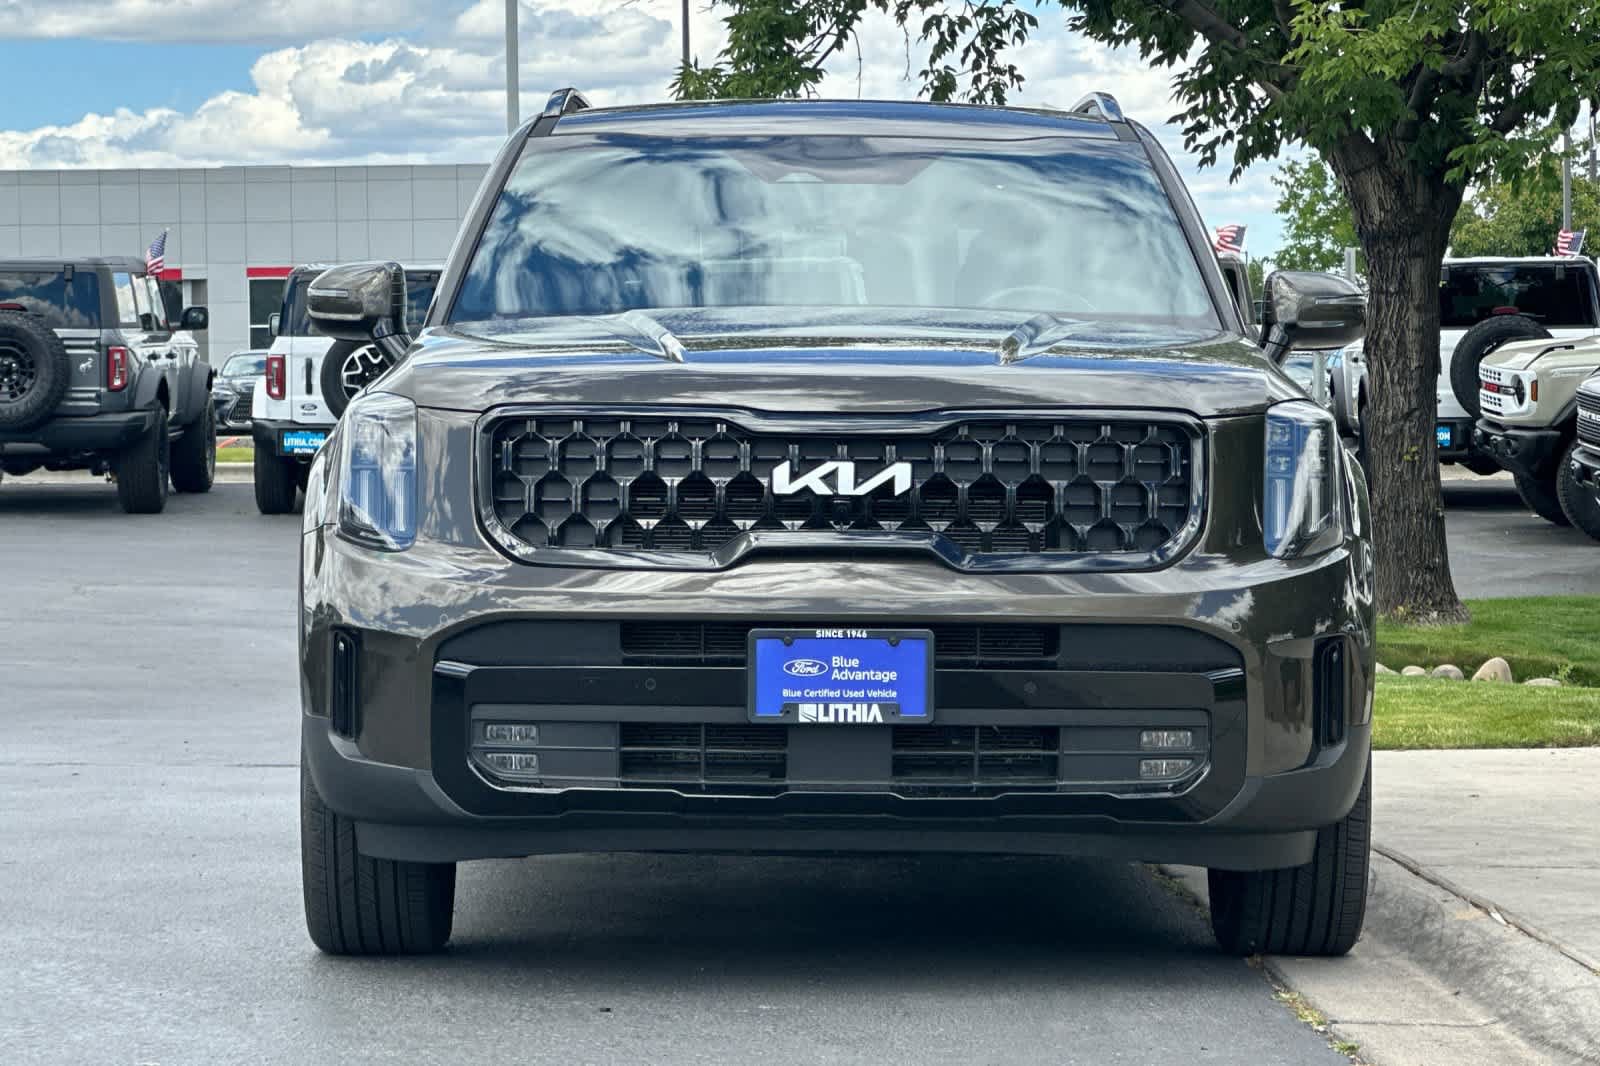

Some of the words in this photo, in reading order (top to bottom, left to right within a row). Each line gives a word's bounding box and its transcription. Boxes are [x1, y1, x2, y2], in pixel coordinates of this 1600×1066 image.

[772, 460, 912, 497] KIA
[816, 629, 843, 638] SINCE
[846, 629, 867, 638] 1946
[790, 661, 820, 674] Ford
[832, 656, 859, 667] Blue
[831, 669, 897, 683] Advantage
[782, 689, 801, 697] Blue
[804, 689, 840, 697] Certified
[843, 689, 864, 697] Used
[867, 689, 897, 697] Vehicle
[818, 703, 883, 723] LITHIA
